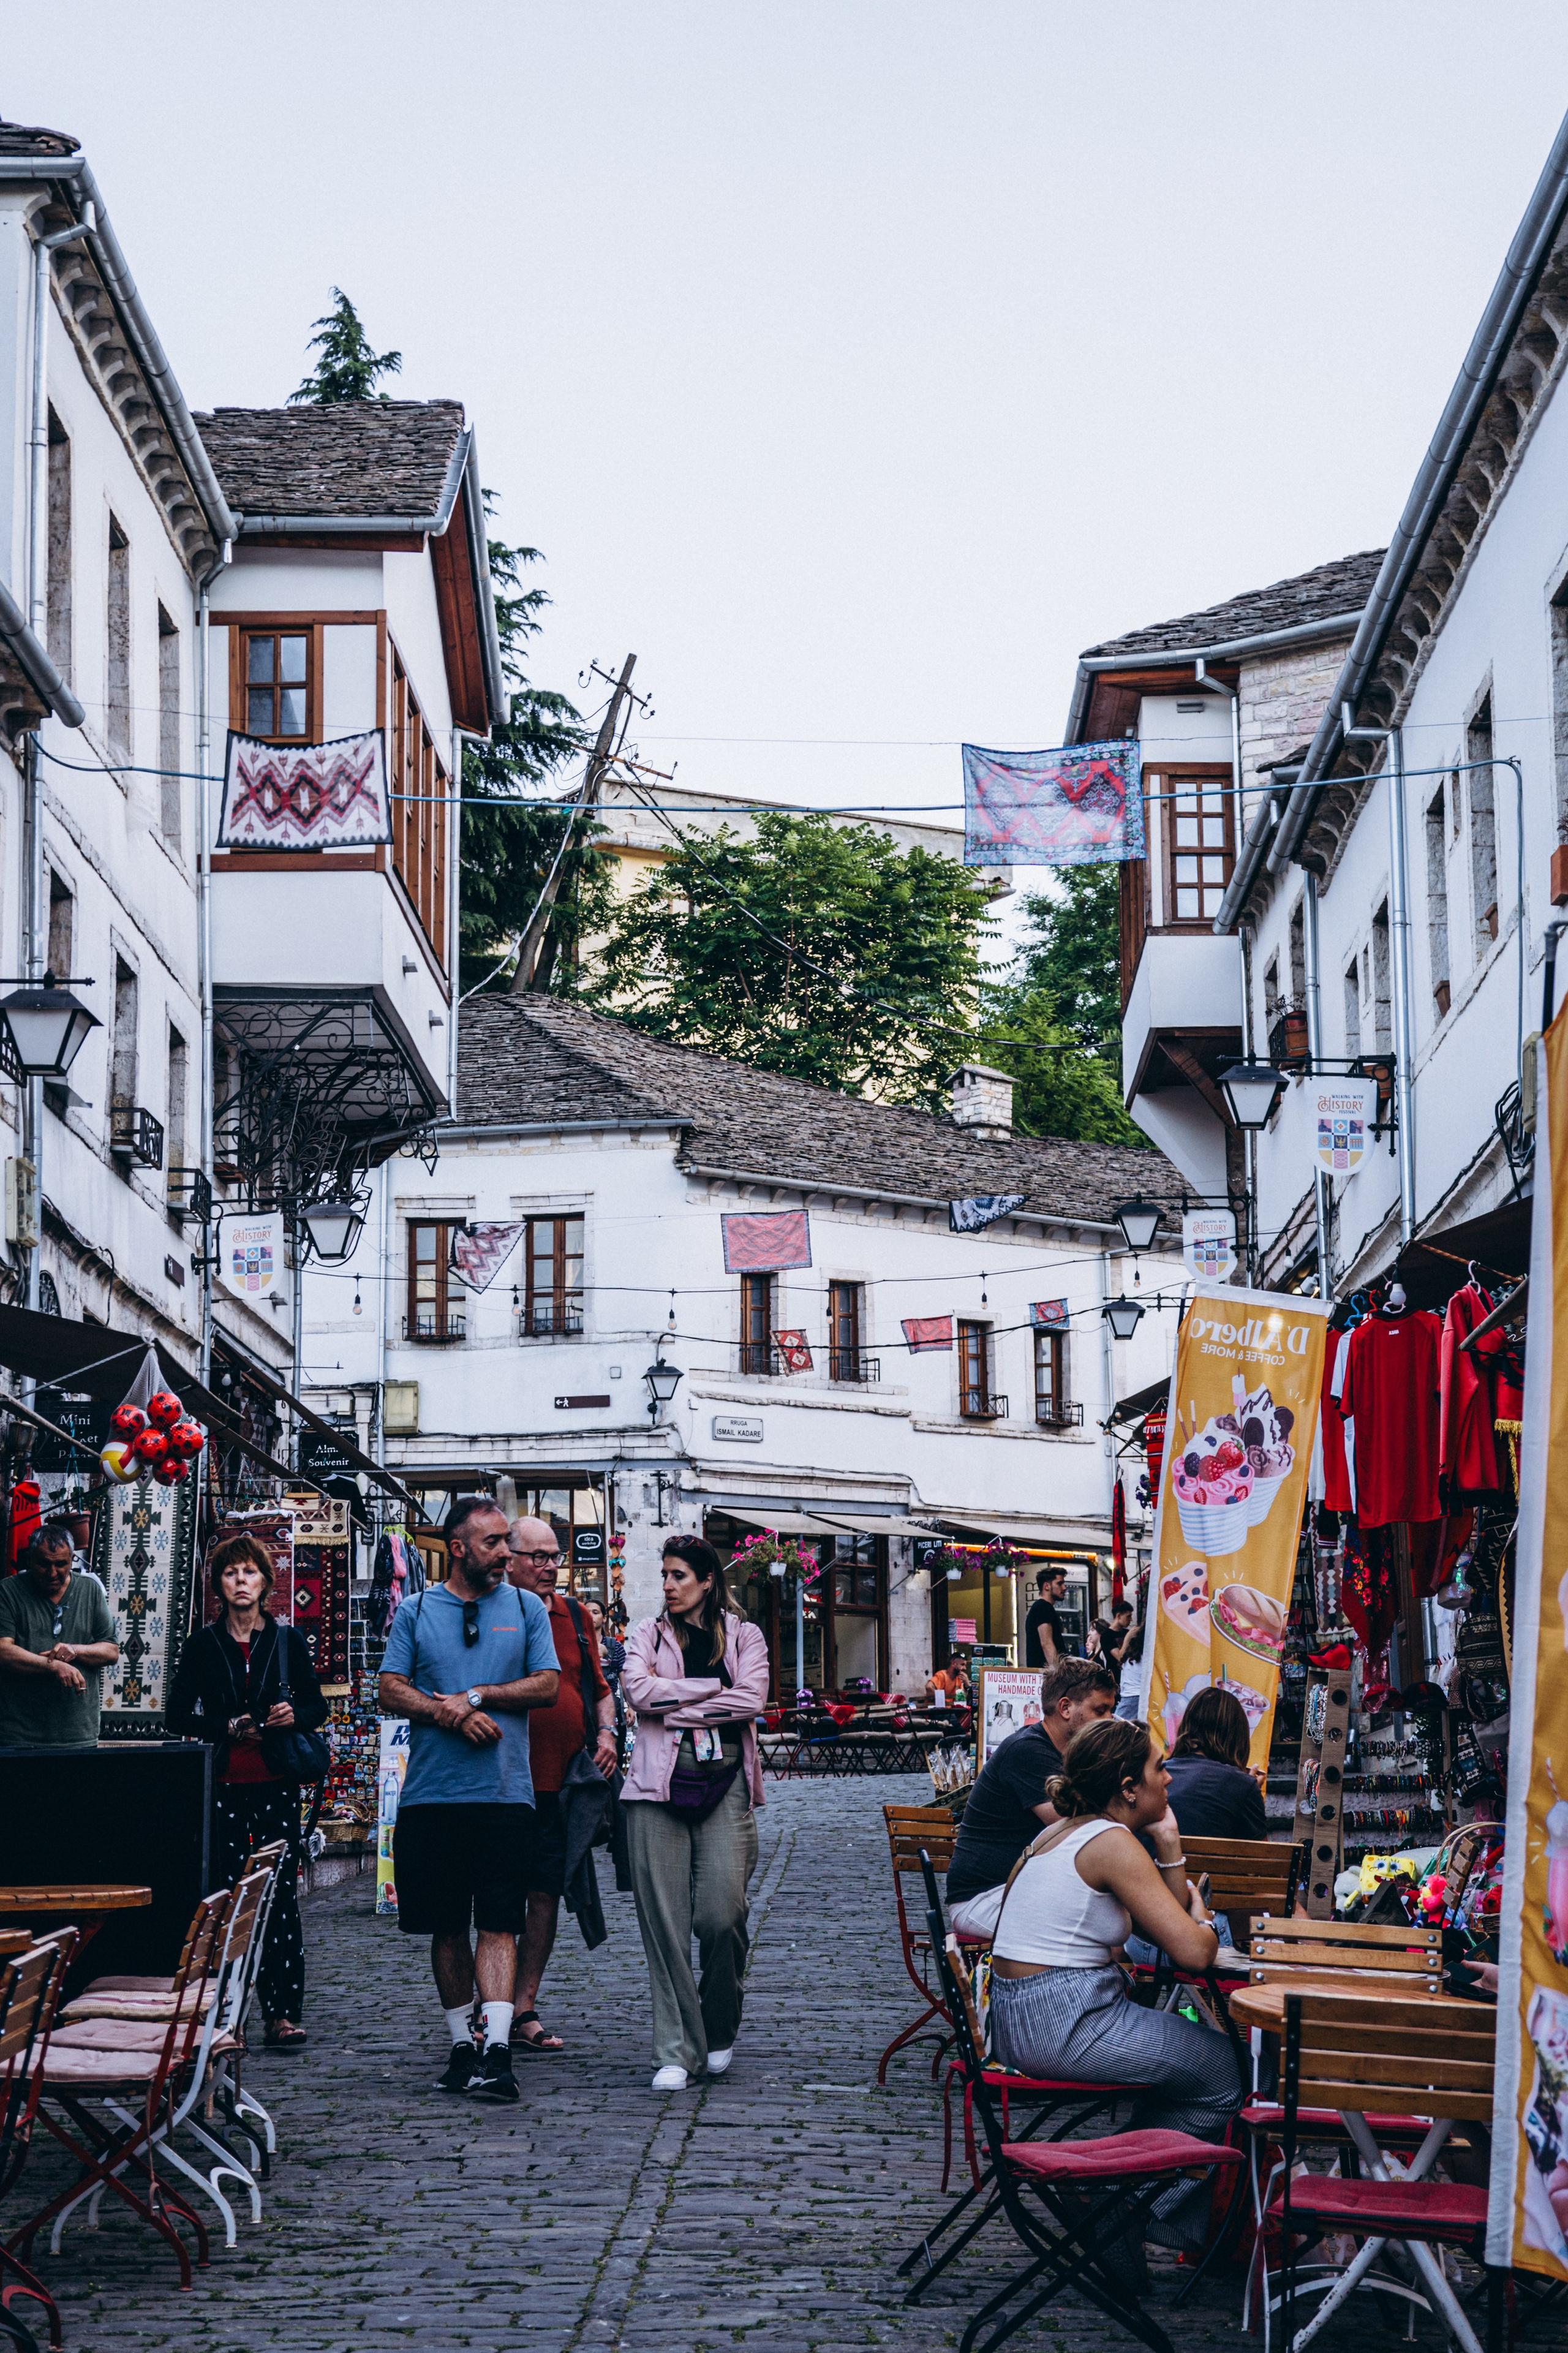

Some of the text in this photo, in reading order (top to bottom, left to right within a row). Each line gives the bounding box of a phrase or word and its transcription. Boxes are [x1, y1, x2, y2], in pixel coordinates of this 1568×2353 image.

[59, 1414, 91, 1425] Mini
[309, 1458, 349, 1467] Souvenir
[987, 1673, 1017, 1683] MUSEUM
[1020, 1674, 1036, 1684] WITH
[998, 1685, 1035, 1695] HANDMADE
